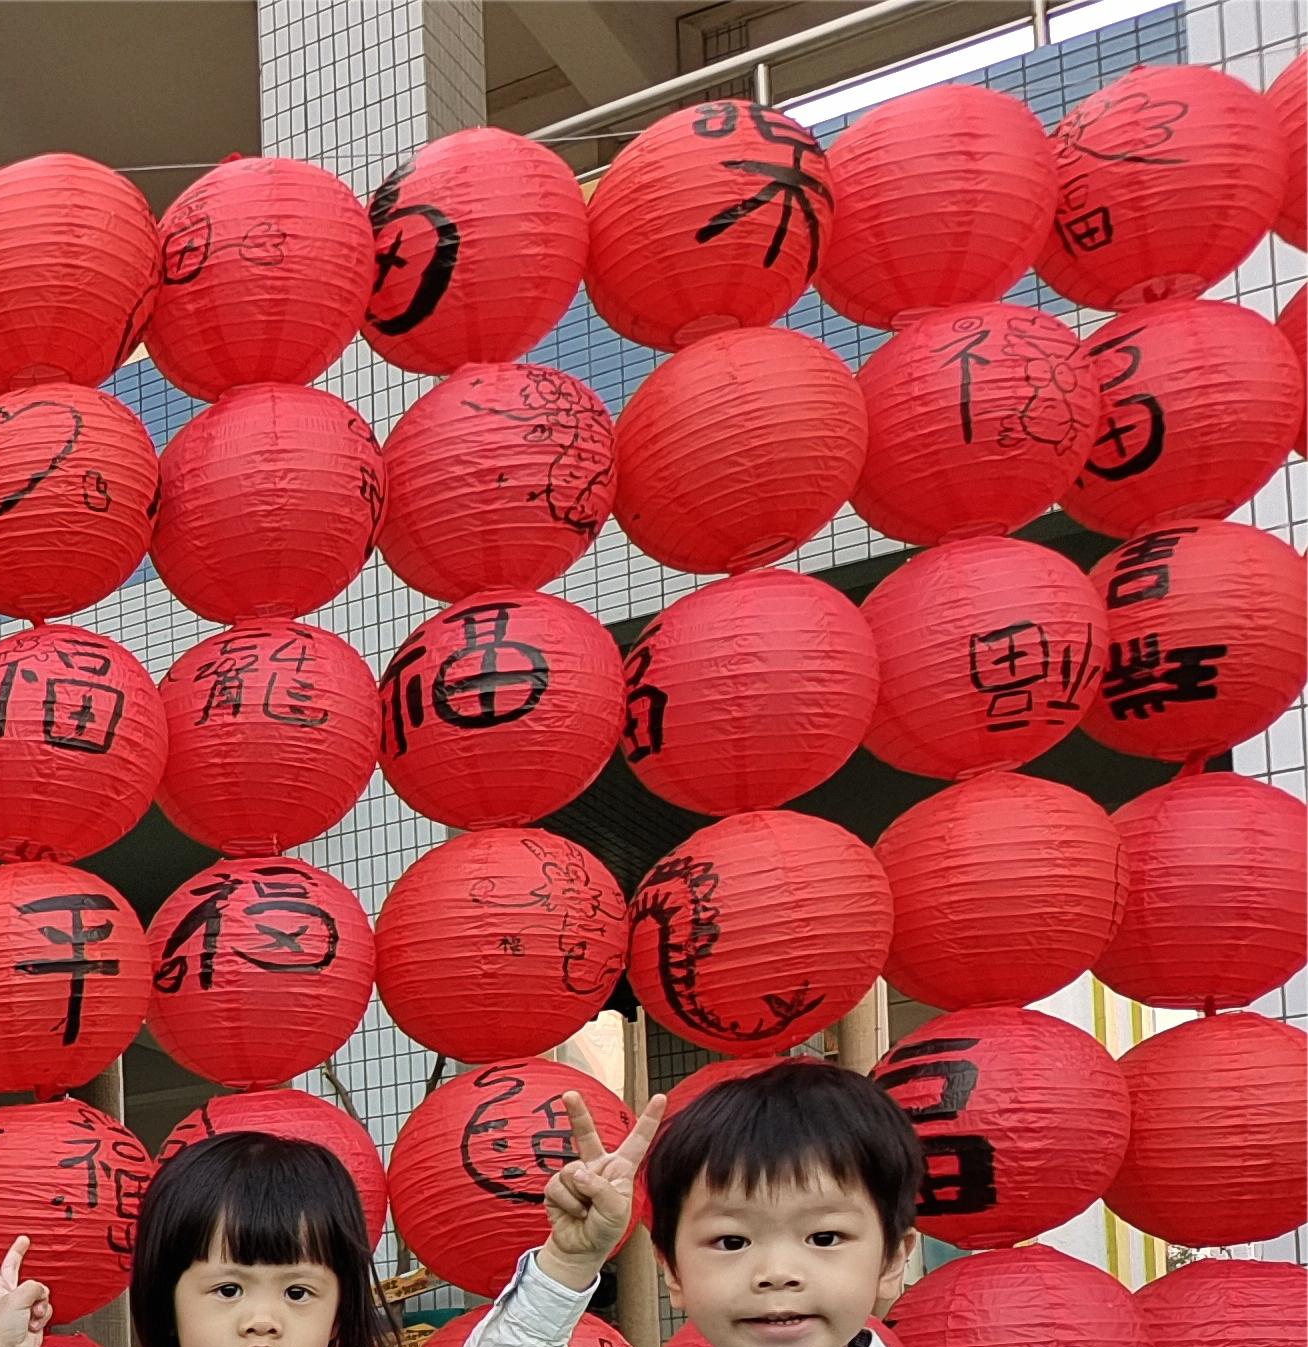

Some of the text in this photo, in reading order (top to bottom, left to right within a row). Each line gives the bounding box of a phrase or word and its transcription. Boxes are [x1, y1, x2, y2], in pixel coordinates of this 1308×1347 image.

[374, 602, 551, 760] 福
[15, 893, 120, 1046] 平
[156, 866, 339, 994] 福
